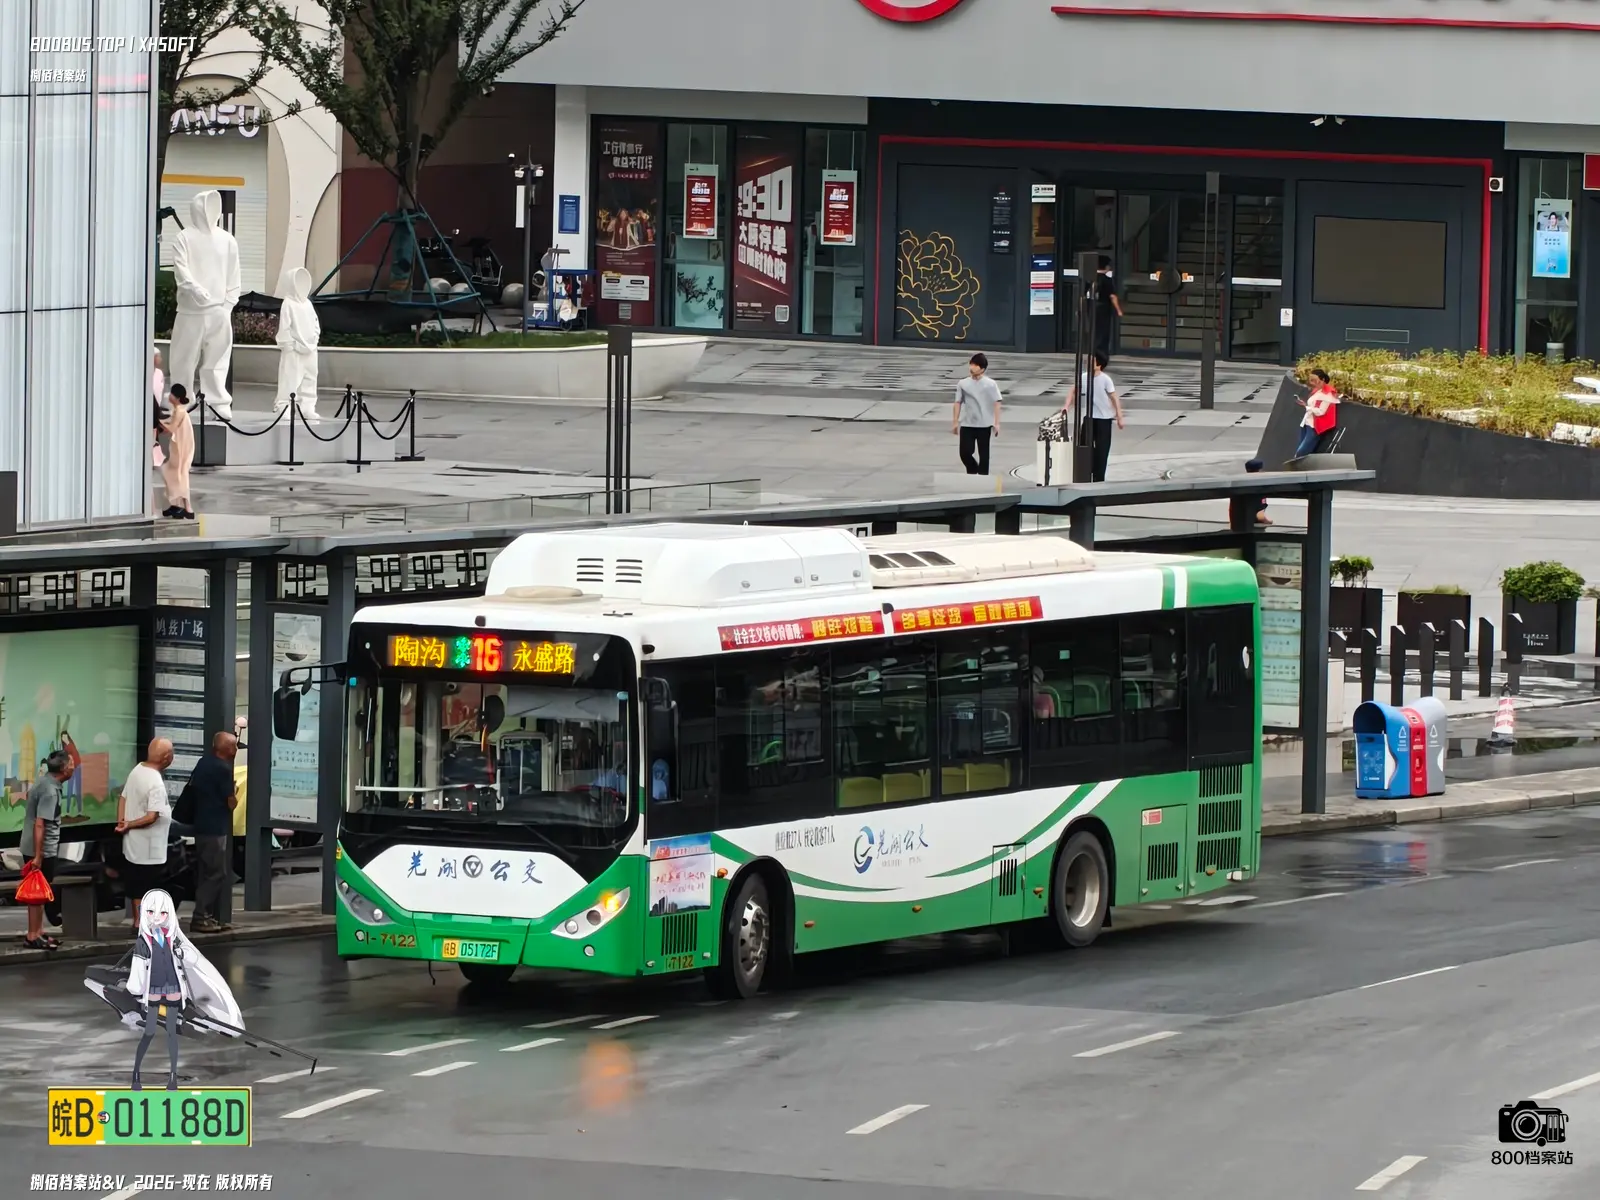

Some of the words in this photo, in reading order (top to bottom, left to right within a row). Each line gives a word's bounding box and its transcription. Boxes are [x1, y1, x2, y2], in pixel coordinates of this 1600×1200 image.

[473, 637, 502, 672] 16
[513, 642, 574, 674] 永盛路
